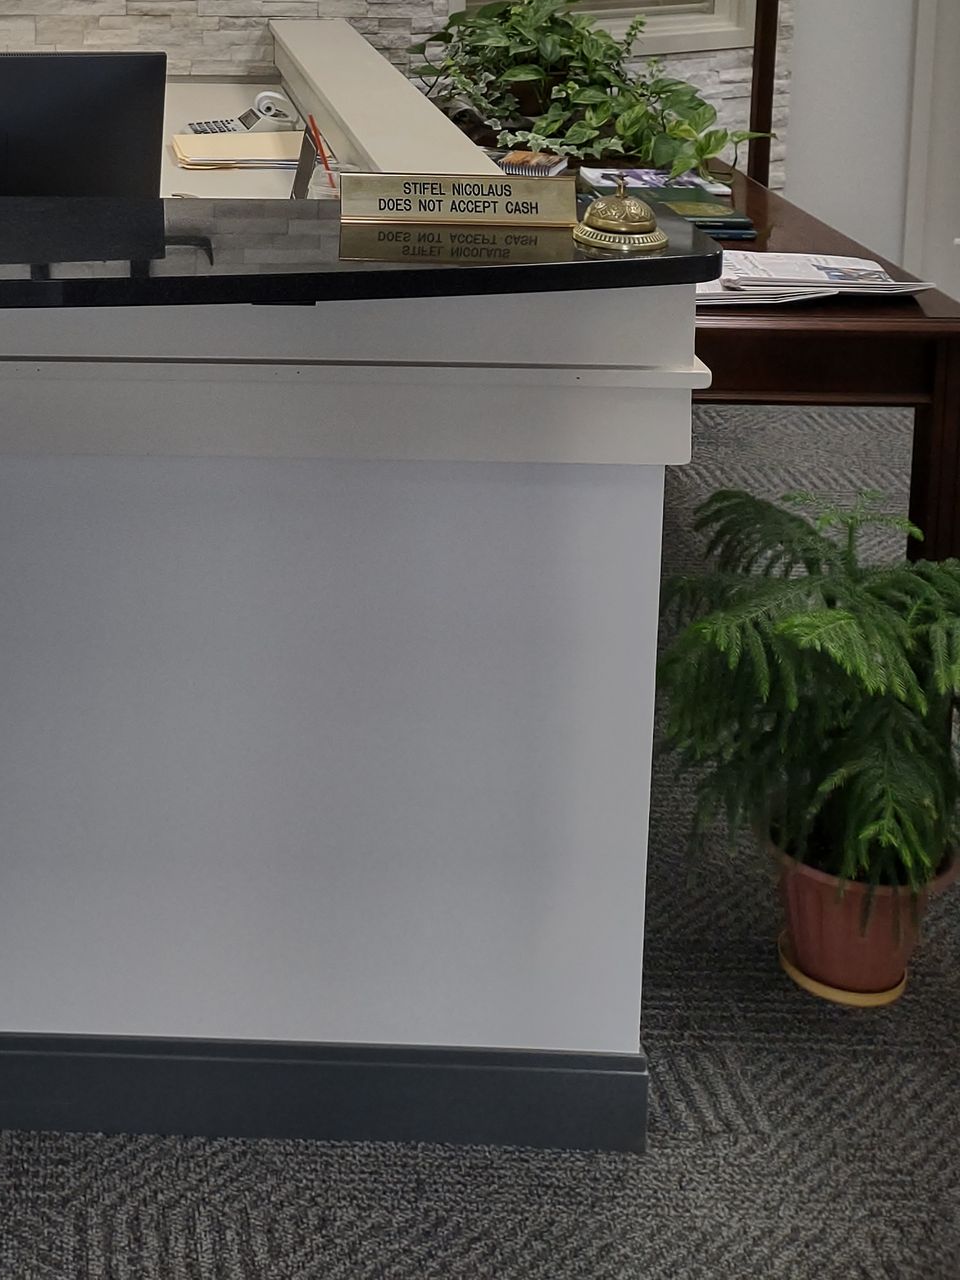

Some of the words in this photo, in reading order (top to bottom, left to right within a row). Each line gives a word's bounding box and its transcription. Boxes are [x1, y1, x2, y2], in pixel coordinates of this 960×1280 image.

[403, 181, 446, 196] STIFEL
[452, 183, 512, 197] NICOLAUS
[378, 198, 412, 212] DOES
[418, 199, 443, 212] NOT
[449, 200, 499, 214] ACCEPT
[505, 201, 539, 215] CASH
